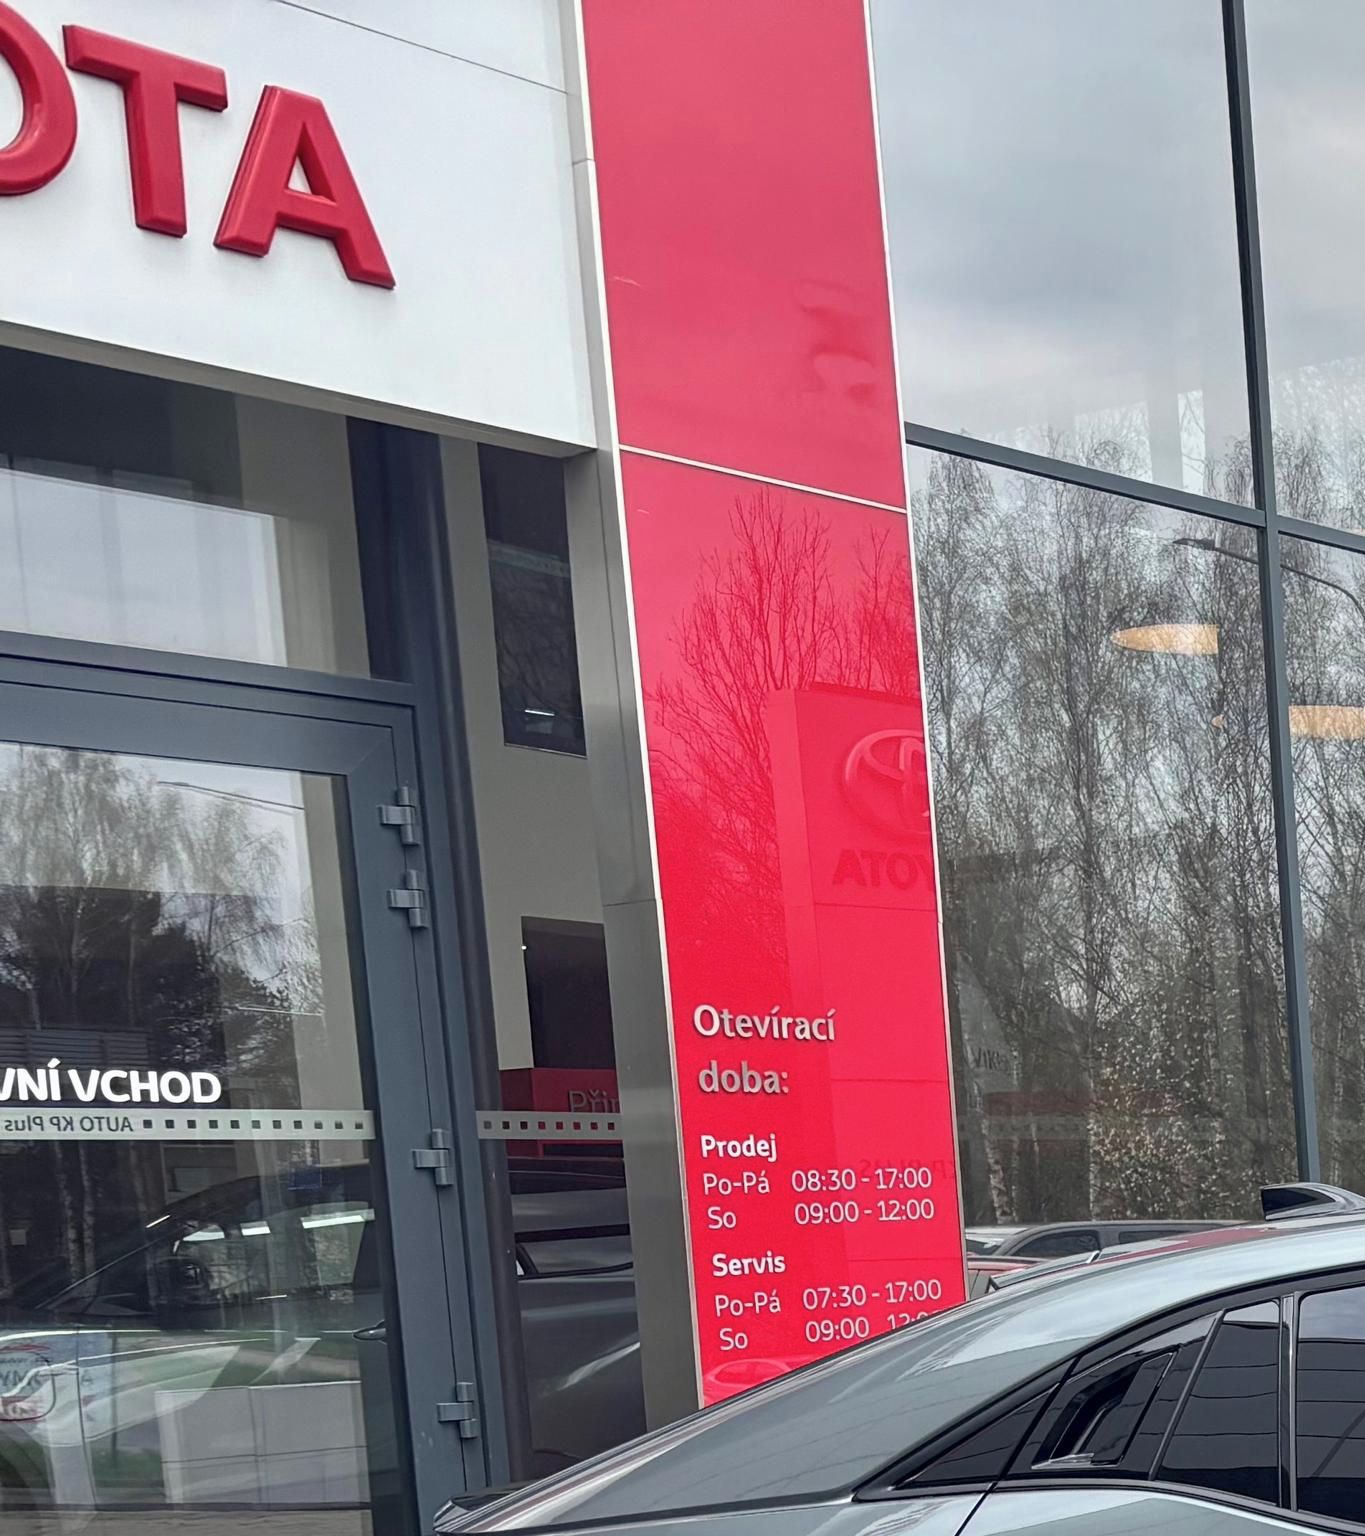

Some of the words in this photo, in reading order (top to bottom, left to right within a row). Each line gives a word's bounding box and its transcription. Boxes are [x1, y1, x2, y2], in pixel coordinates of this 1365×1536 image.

[693, 1004, 835, 1041] Otevírací
[68, 1069, 222, 1103] VCHOD
[698, 1061, 790, 1094] doba:
[700, 1133, 777, 1162] Prodej
[703, 1170, 770, 1195] Po-Pá
[791, 1169, 856, 1192] 08:30
[874, 1166, 932, 1190] 17:00
[707, 1206, 737, 1230] So
[794, 1201, 860, 1225] 09:00
[877, 1198, 935, 1222] 12:00
[712, 1250, 786, 1278] Servis
[715, 1291, 781, 1317] Po-Pá
[803, 1286, 866, 1310] 07:30
[885, 1279, 942, 1303] 17:00
[719, 1329, 748, 1351] So
[804, 1316, 869, 1343] 09:00
